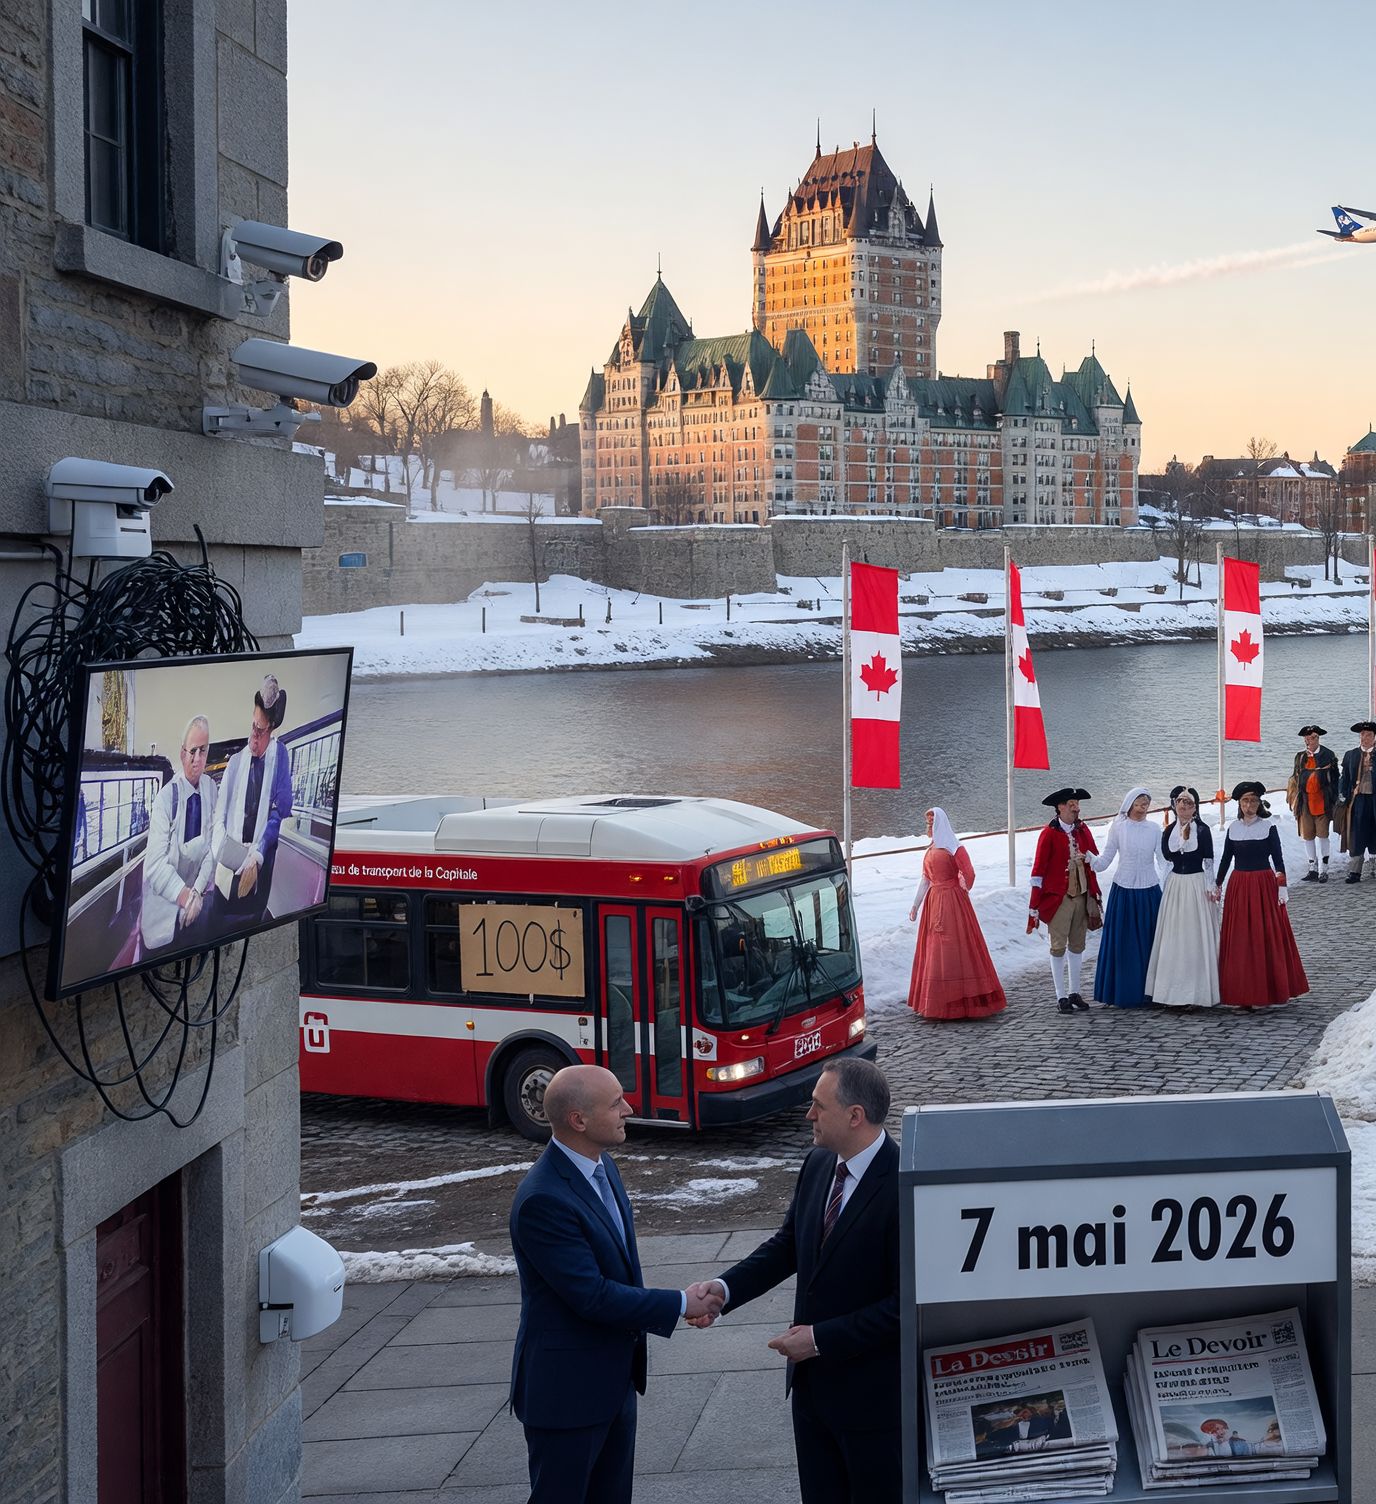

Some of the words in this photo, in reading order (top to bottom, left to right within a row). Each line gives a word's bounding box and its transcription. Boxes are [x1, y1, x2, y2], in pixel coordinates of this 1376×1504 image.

[348, 864, 359, 876] de
[424, 866, 433, 878] la
[435, 866, 478, 881] Capitale
[473, 917, 572, 981] 100$
[960, 1207, 995, 1273] 7
[1017, 1204, 1126, 1271] mai
[1150, 1193, 1295, 1263] 2026
[1150, 1340, 1182, 1359] Le
[1186, 1331, 1268, 1356] Devoir
[932, 1357, 965, 1376] La
